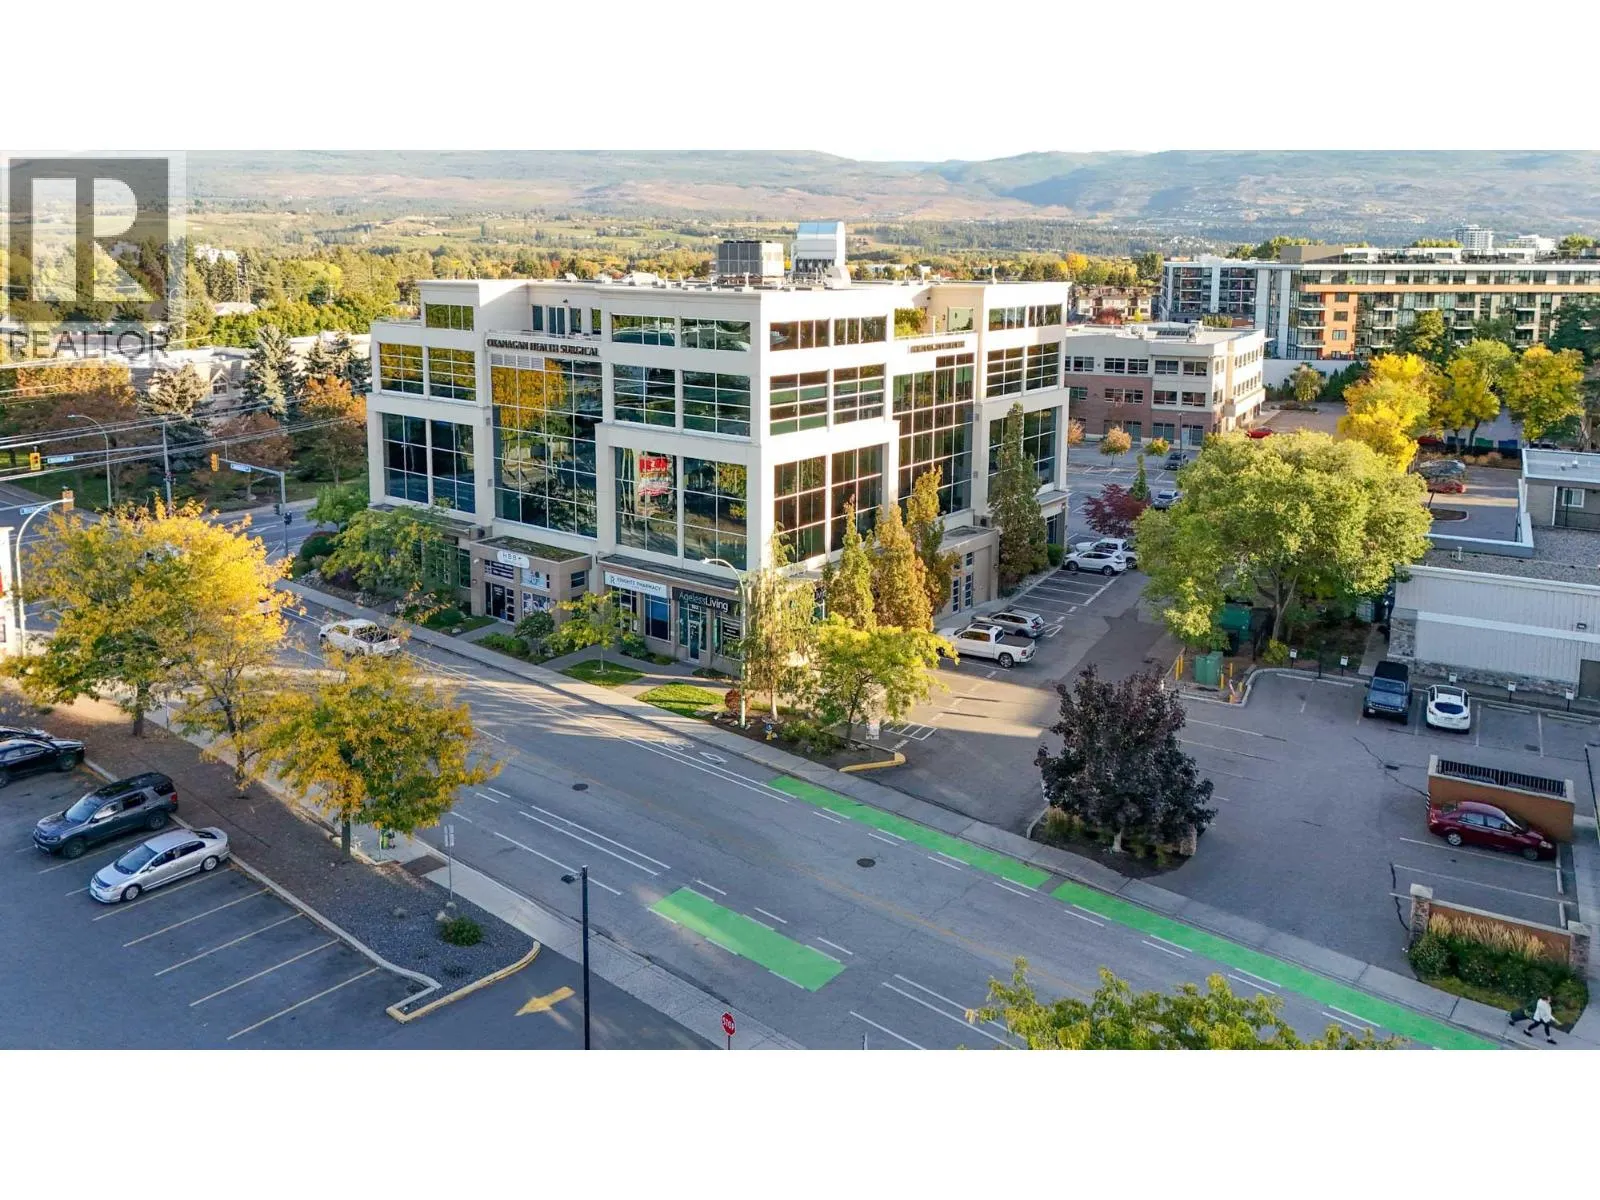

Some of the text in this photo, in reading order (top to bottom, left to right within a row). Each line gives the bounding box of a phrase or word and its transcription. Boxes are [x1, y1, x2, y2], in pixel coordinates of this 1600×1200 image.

[530, 342, 559, 353] HEALTH
[560, 344, 600, 356] SURGICAL
[636, 581, 662, 592] PHARMACY
[722, 1016, 734, 1030] STOP
